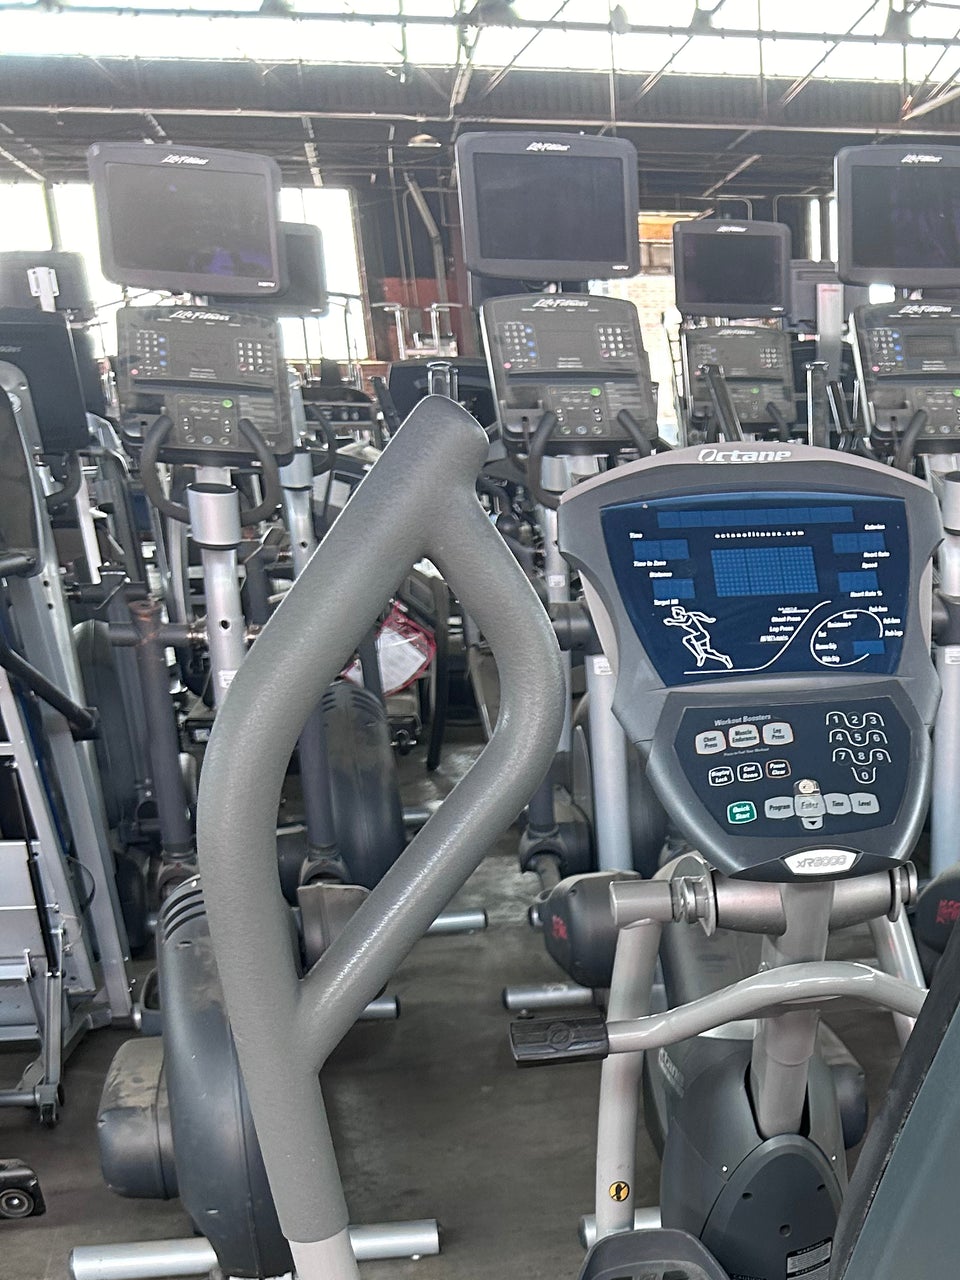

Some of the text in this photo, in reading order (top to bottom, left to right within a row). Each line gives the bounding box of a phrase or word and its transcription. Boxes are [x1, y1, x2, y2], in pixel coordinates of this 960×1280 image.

[697, 449, 791, 462] Octane
[714, 714, 771, 726] Workout Boosters
[873, 734, 880, 742] 6
[839, 752, 846, 760] 7
[858, 752, 865, 760] 8
[861, 772, 869, 780] 0
[733, 805, 750, 813] Quick
[801, 801, 818, 809] Enter
